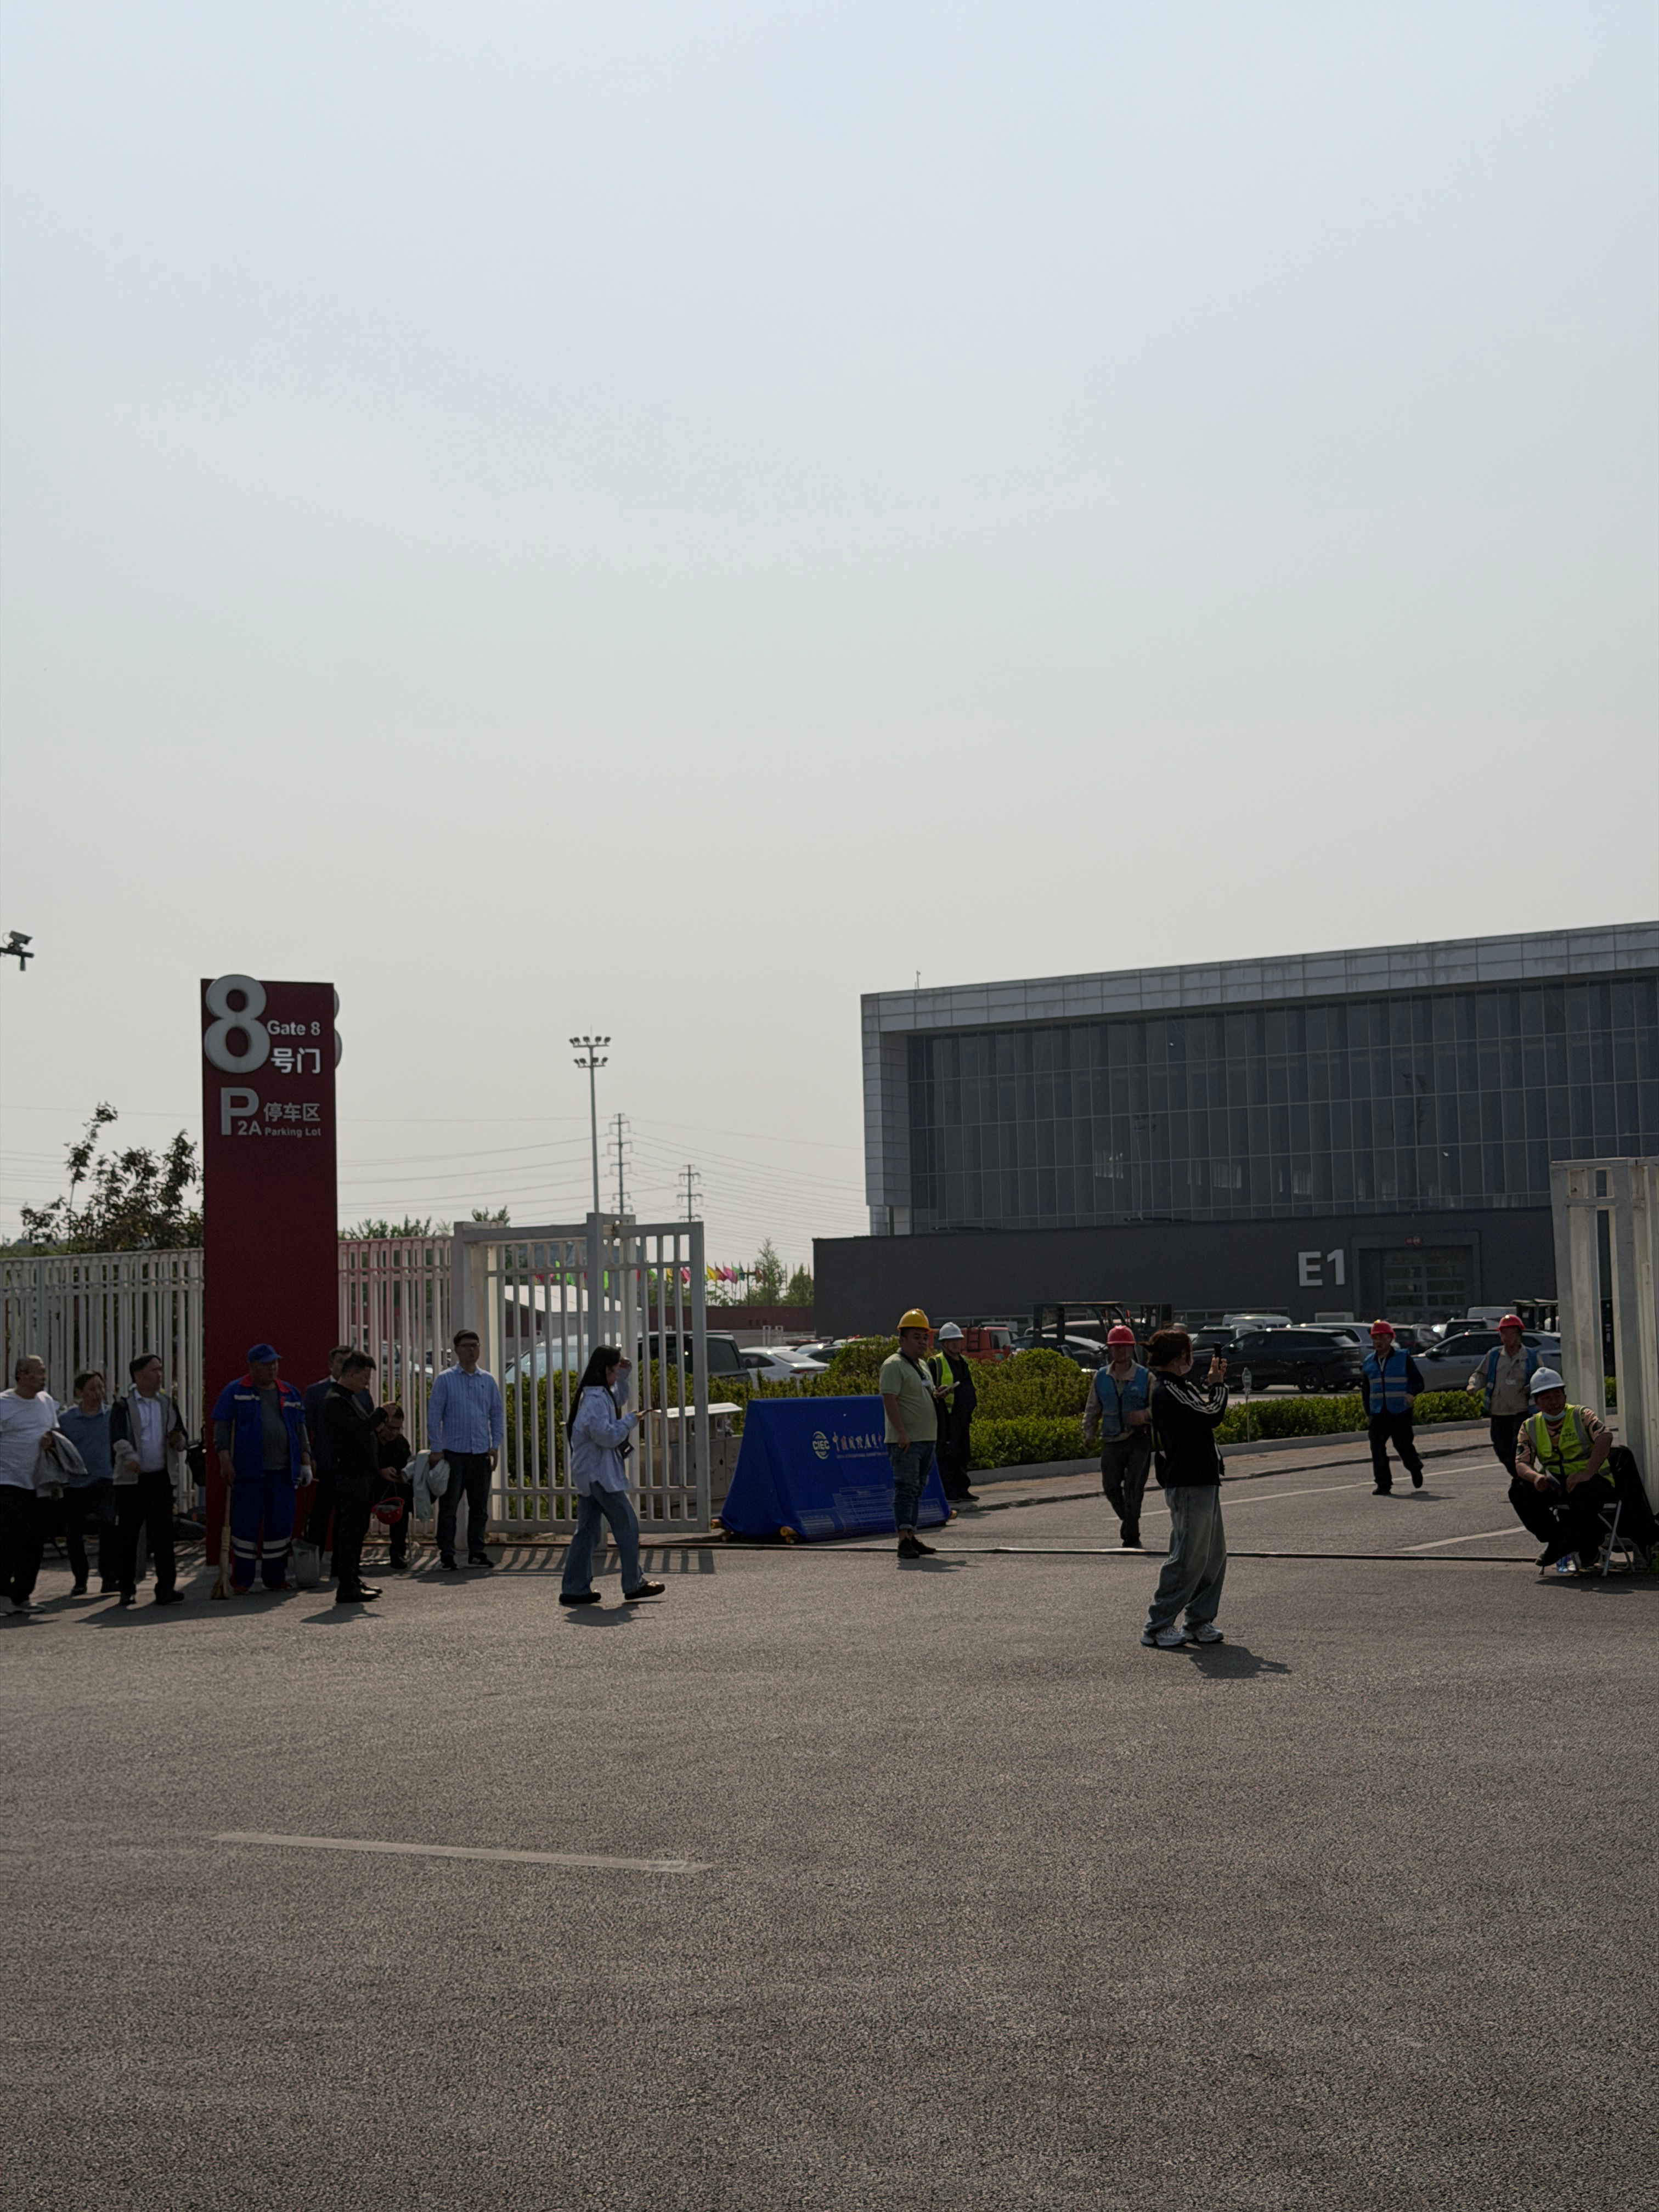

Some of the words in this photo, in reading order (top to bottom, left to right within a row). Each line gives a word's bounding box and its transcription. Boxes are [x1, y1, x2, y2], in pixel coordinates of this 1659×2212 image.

[204, 974, 270, 1074] 8
[267, 1020, 306, 1036] Gate
[311, 1022, 320, 1036] 8
[270, 1047, 321, 1074] 号门
[221, 1087, 259, 1136] P
[263, 1102, 321, 1122] 停车区
[238, 1120, 262, 1136] 2A
[265, 1127, 302, 1138] Parking
[305, 1127, 321, 1136] Lot
[1298, 1249, 1345, 1286] E1
[812, 1440, 830, 1451] CIEC
